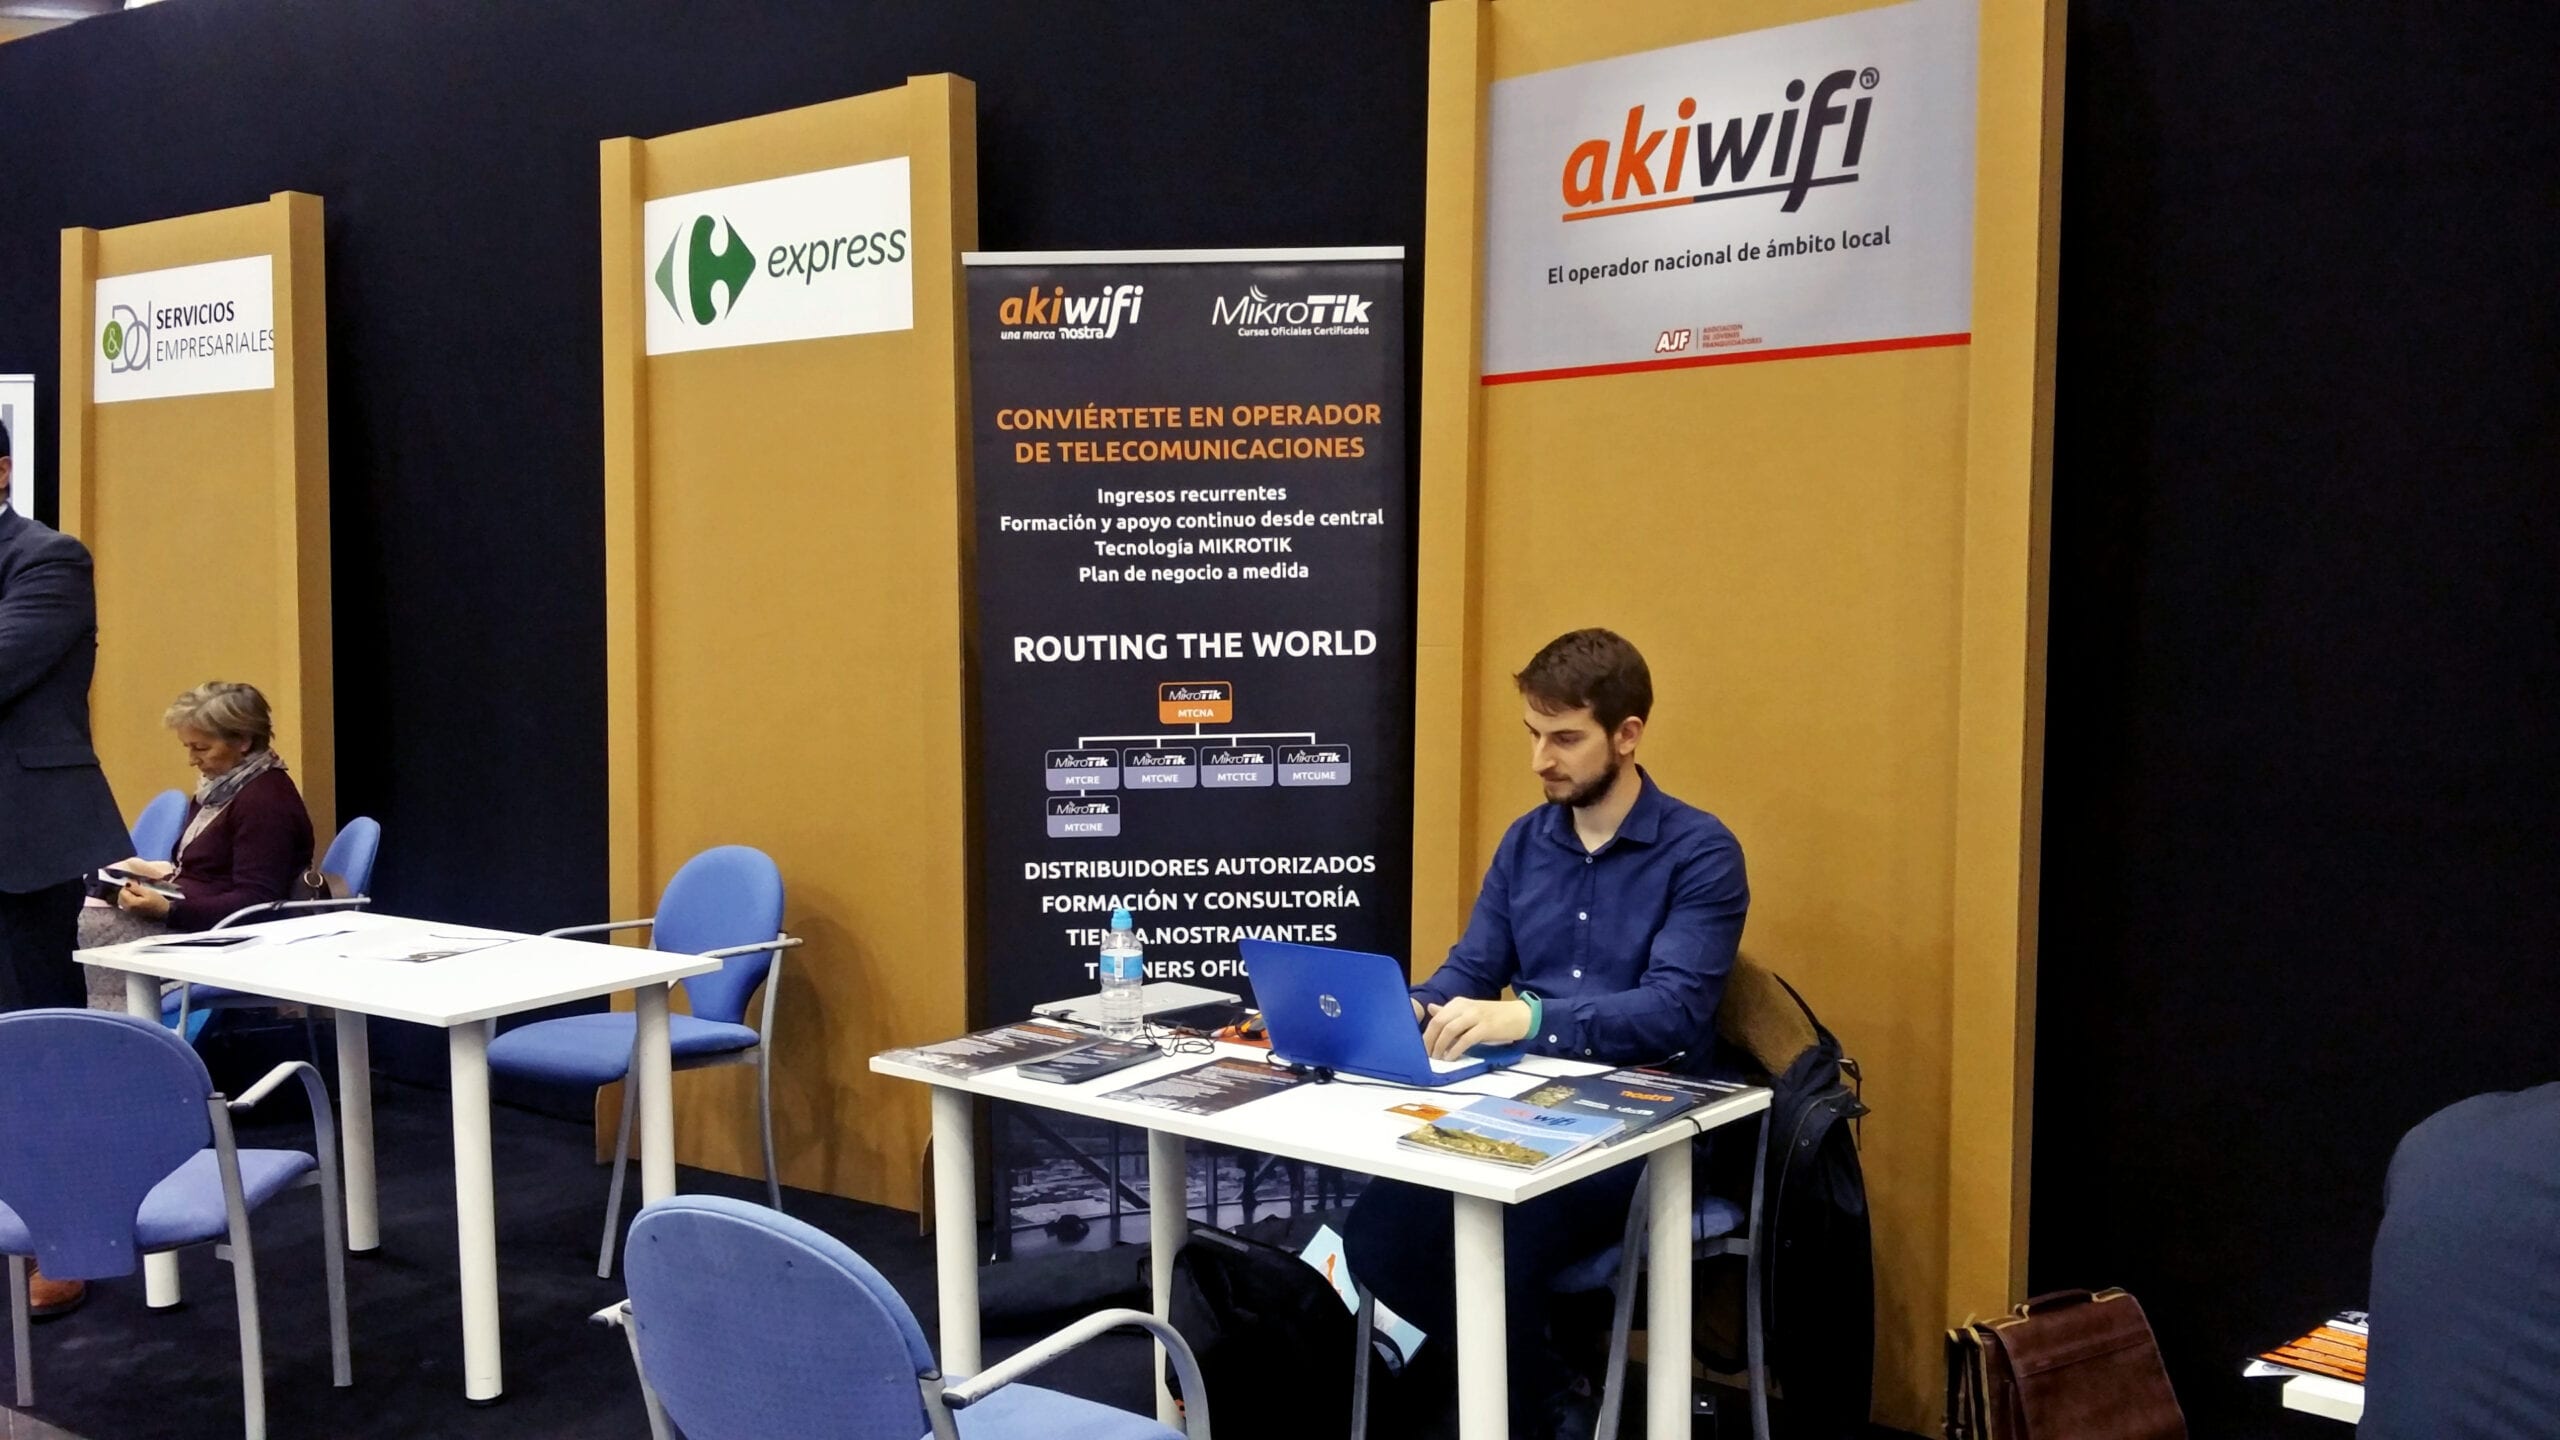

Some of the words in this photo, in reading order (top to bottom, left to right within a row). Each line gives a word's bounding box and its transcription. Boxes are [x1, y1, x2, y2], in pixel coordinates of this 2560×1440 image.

[1562, 69, 1874, 213] akiwifi
[767, 229, 907, 286] express
[1548, 267, 1564, 284] El
[1568, 257, 1649, 285] operador
[1654, 245, 1732, 272] nacional
[1737, 242, 1760, 262] de
[1766, 234, 1836, 260] ámbito
[1842, 225, 1891, 250] local
[156, 300, 235, 330] SERVICIOS
[999, 284, 1144, 339] akiwifi
[1211, 293, 1374, 326] MikroTik
[1000, 330, 1021, 341] una
[1022, 330, 1056, 341] marca
[1058, 326, 1105, 340] nostra
[1237, 327, 1270, 337] Cursos
[1270, 326, 1313, 337] Oficiales
[1313, 325, 1370, 336] Certificados
[1655, 328, 1691, 353] AJF
[996, 402, 1182, 431] CONVIÉRTETE
[1189, 406, 1224, 428] EN
[1231, 403, 1382, 427] OPERADOR
[1015, 442, 1051, 464] DE
[1057, 436, 1366, 463] TELECOMUNICACIONES
[1097, 488, 1176, 507] Ingresos
[1180, 485, 1287, 502] recurrentes
[1000, 514, 1096, 532] Formación
[1100, 518, 1112, 533] y
[1116, 517, 1172, 532] apoyo
[1176, 511, 1256, 529] continuo
[1260, 510, 1316, 527] desde
[1320, 509, 1384, 526] central
[1094, 538, 1194, 558] Tecnología
[1198, 537, 1293, 554] MIKROTIK
[1079, 566, 1120, 583] Plan
[1123, 565, 1147, 582] de
[1151, 563, 1223, 584] negocio
[1227, 566, 1239, 580] a
[1243, 562, 1309, 579] medida
[1013, 633, 1168, 663] ROUTING
[1176, 632, 1243, 659] THE
[1251, 629, 1377, 658] WORLD
[1177, 708, 1214, 718] MTCNA
[1065, 775, 1100, 785] MTCRE
[1141, 774, 1179, 783] MTCWE
[1217, 772, 1258, 782] MTCTCE
[1292, 771, 1336, 781] MTCUME
[1064, 822, 1103, 832] MTCINE
[1024, 858, 1209, 880] DISTRIBUIDORES
[1214, 855, 1376, 876] AUTORIZADOS
[1042, 888, 1178, 913] FORMACIÓN
[1183, 892, 1199, 910] Y
[1203, 885, 1360, 910] CONSULTORÍA
[1066, 924, 1338, 946] TIENA.NOSTRAVANT.ES
[1085, 960, 1195, 980] TNERS
